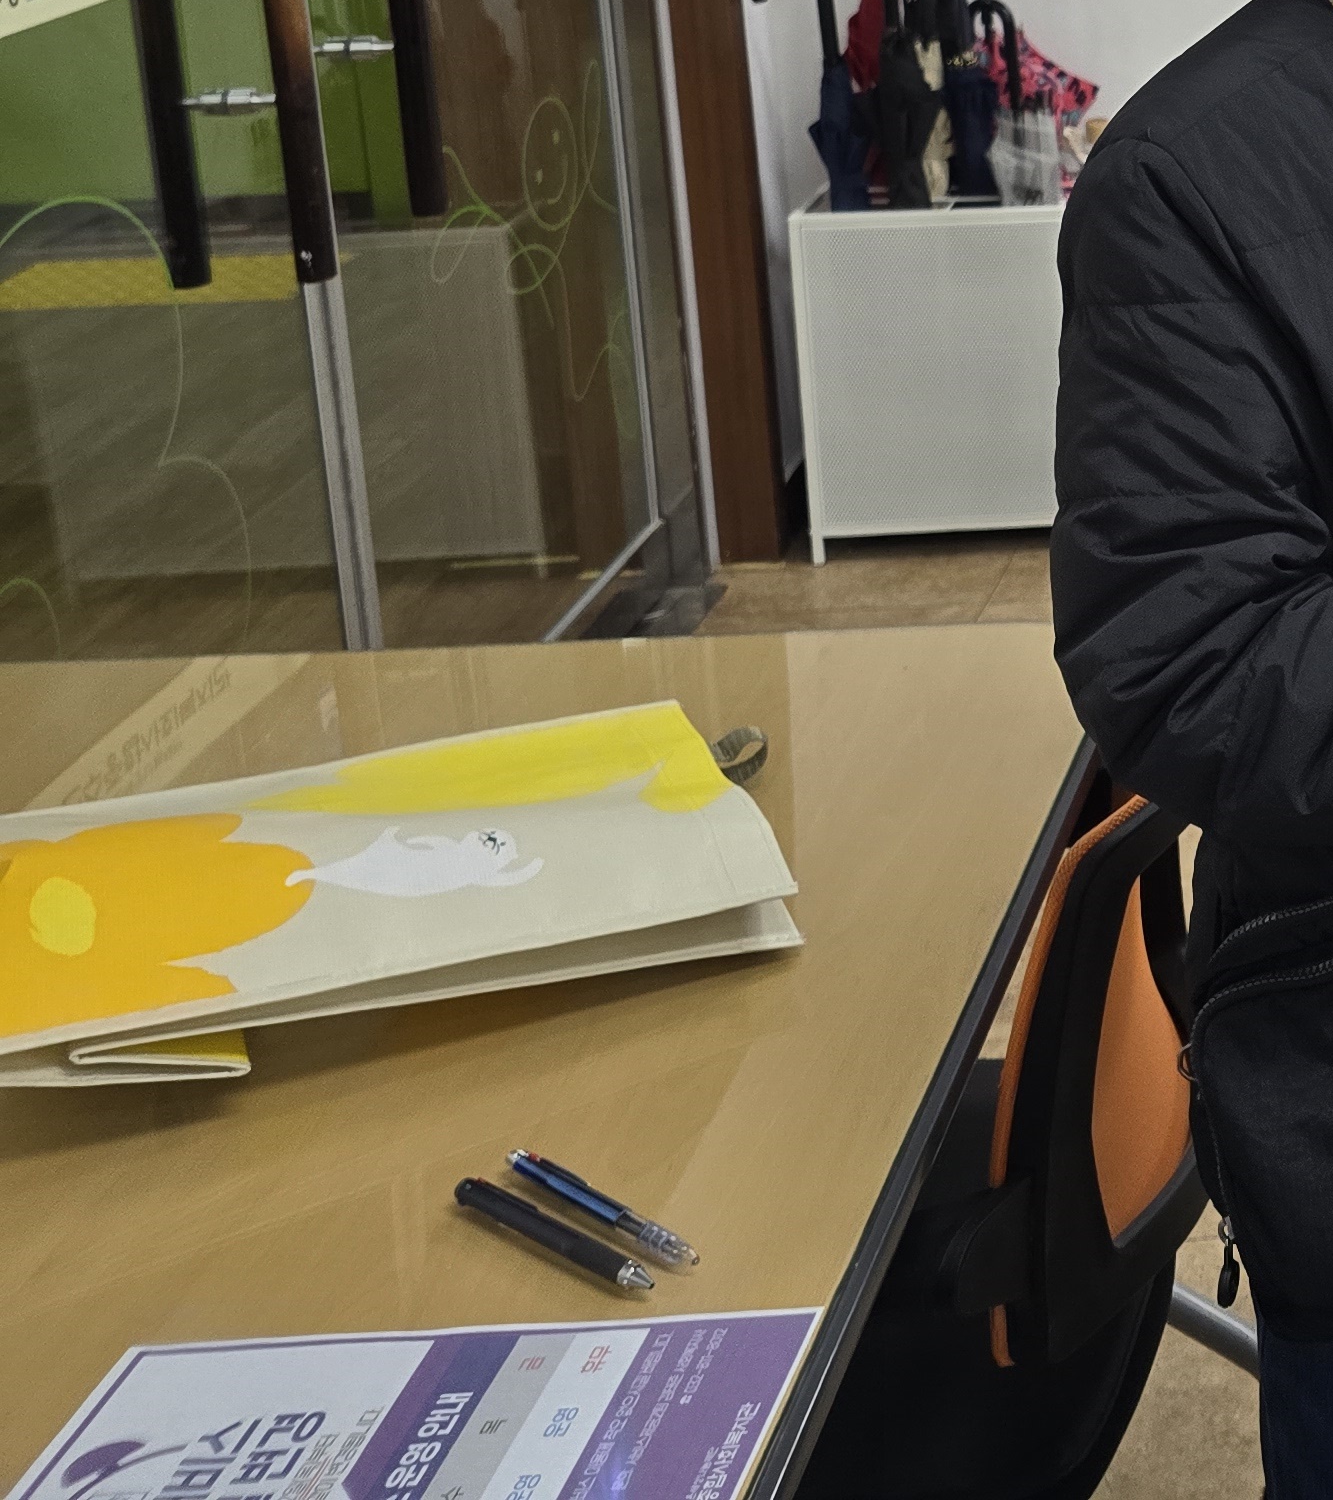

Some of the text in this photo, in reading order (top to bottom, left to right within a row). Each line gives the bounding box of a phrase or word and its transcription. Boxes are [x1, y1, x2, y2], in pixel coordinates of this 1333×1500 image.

[479, 1418, 508, 1435] 목
[518, 1356, 546, 1371] 금
[542, 1407, 579, 1438] 운영
[580, 1345, 612, 1373] 휴무
[603, 1418, 629, 1441] 착오
[229, 1410, 327, 1485] 변경
[385, 1441, 442, 1489] 운영
[417, 1391, 474, 1438] 안내
